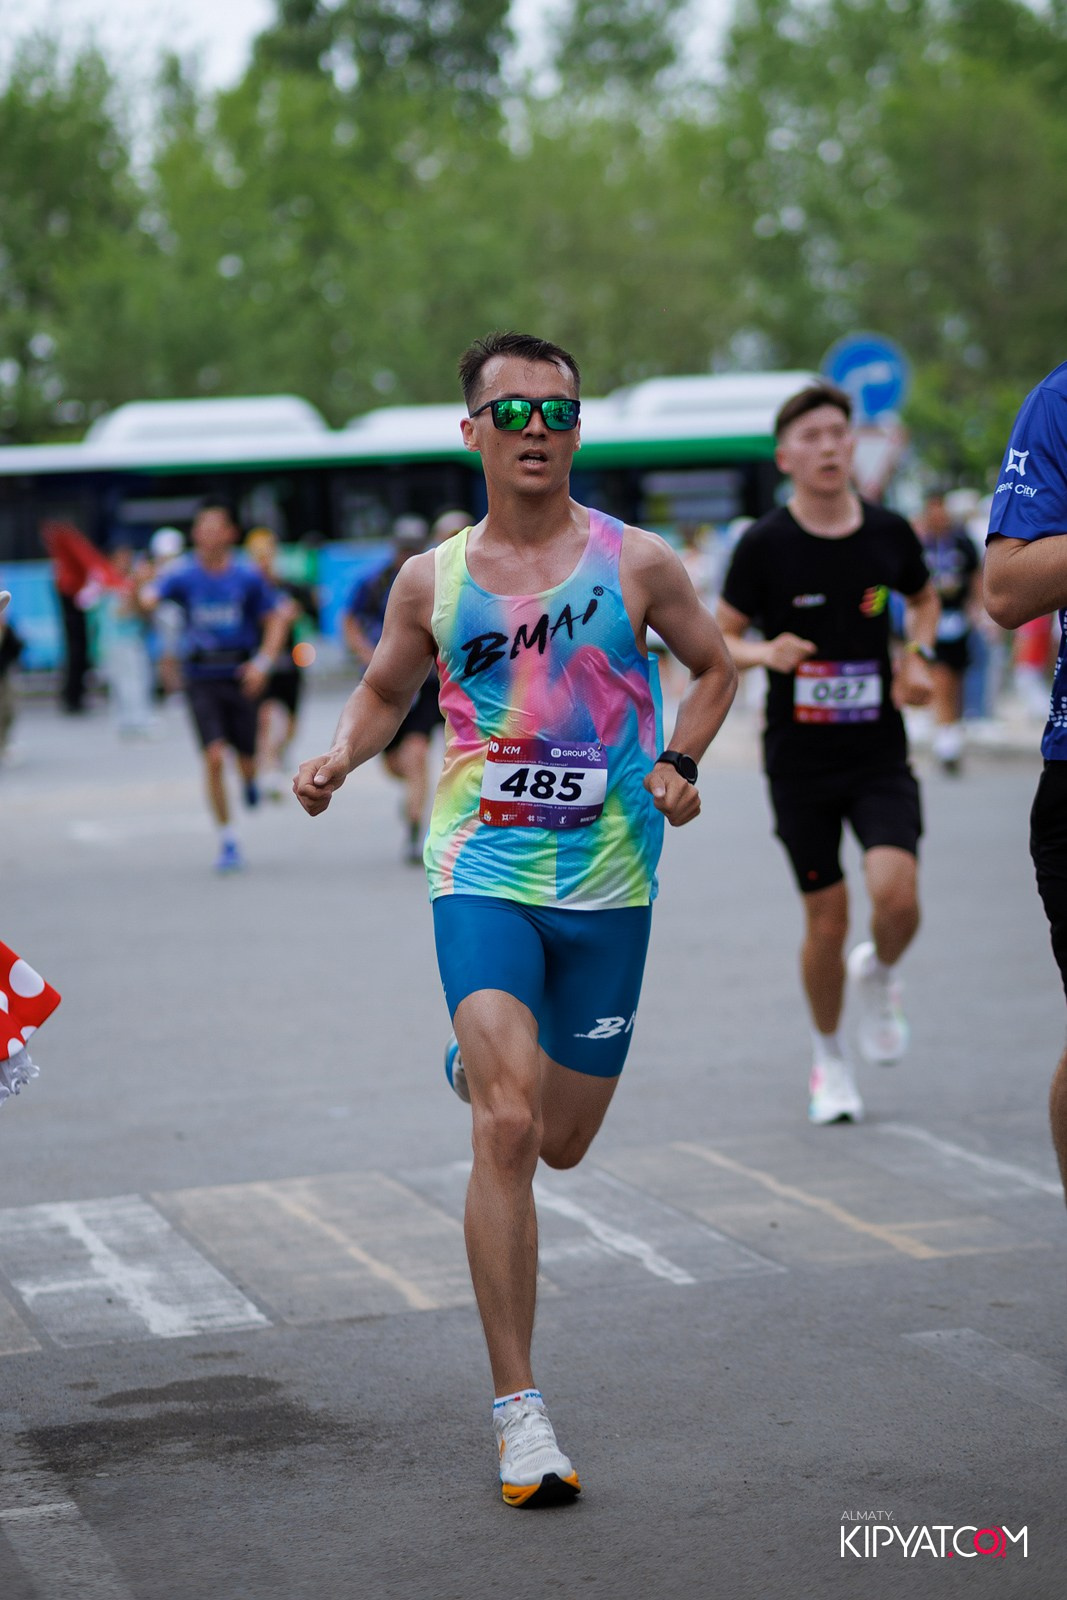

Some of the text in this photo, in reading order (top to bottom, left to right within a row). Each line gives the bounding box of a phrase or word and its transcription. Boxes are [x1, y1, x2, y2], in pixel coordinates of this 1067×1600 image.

[1014, 484, 1037, 498] City
[489, 741, 521, 755] 10 KM
[499, 767, 585, 802] 485
